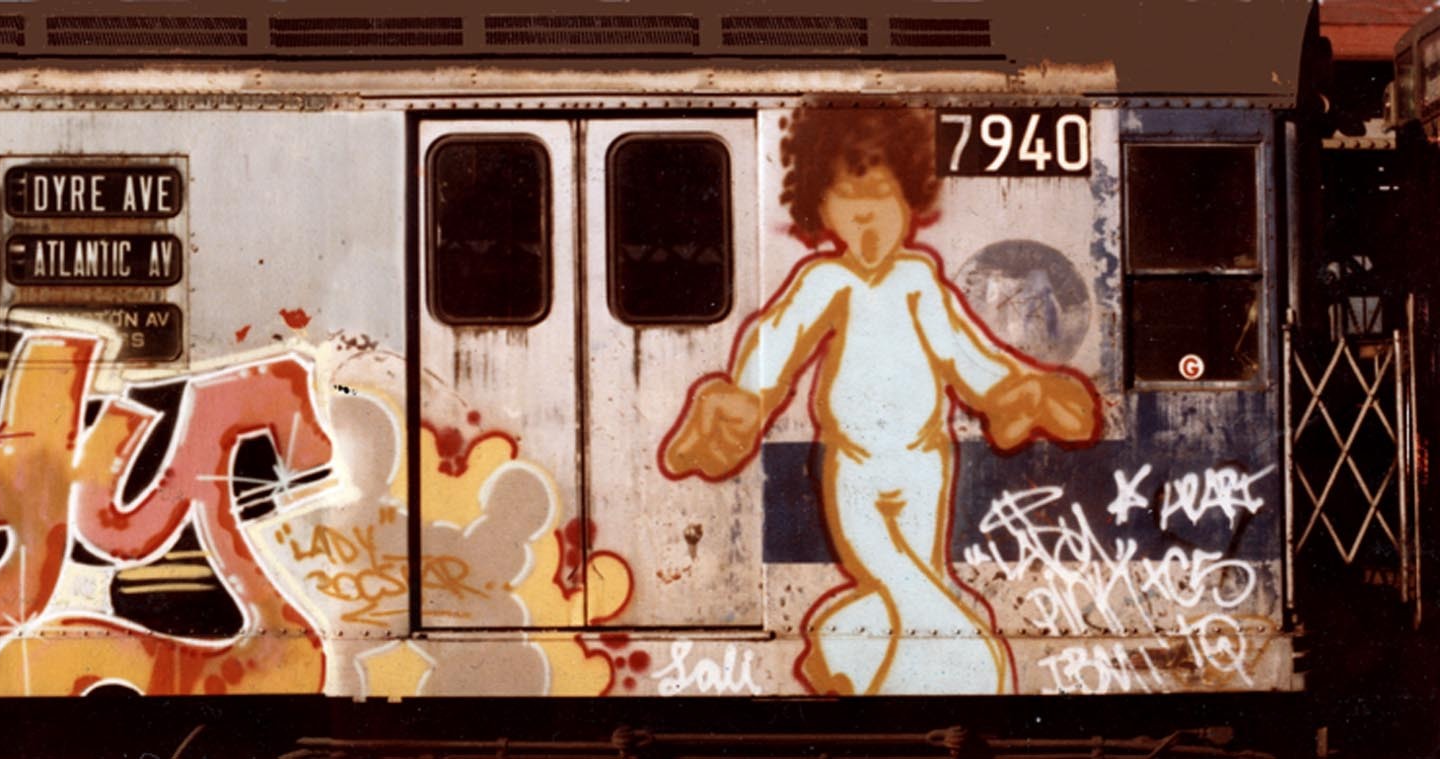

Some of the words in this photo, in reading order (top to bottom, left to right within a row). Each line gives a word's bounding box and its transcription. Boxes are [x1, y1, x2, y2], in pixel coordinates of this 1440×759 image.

[940, 114, 1089, 171] 7940
[34, 176, 105, 211] DYRE
[123, 176, 172, 211] AVE
[34, 241, 131, 277] ATLANTIC
[149, 241, 172, 277] AV
[146, 312, 169, 327] AV
